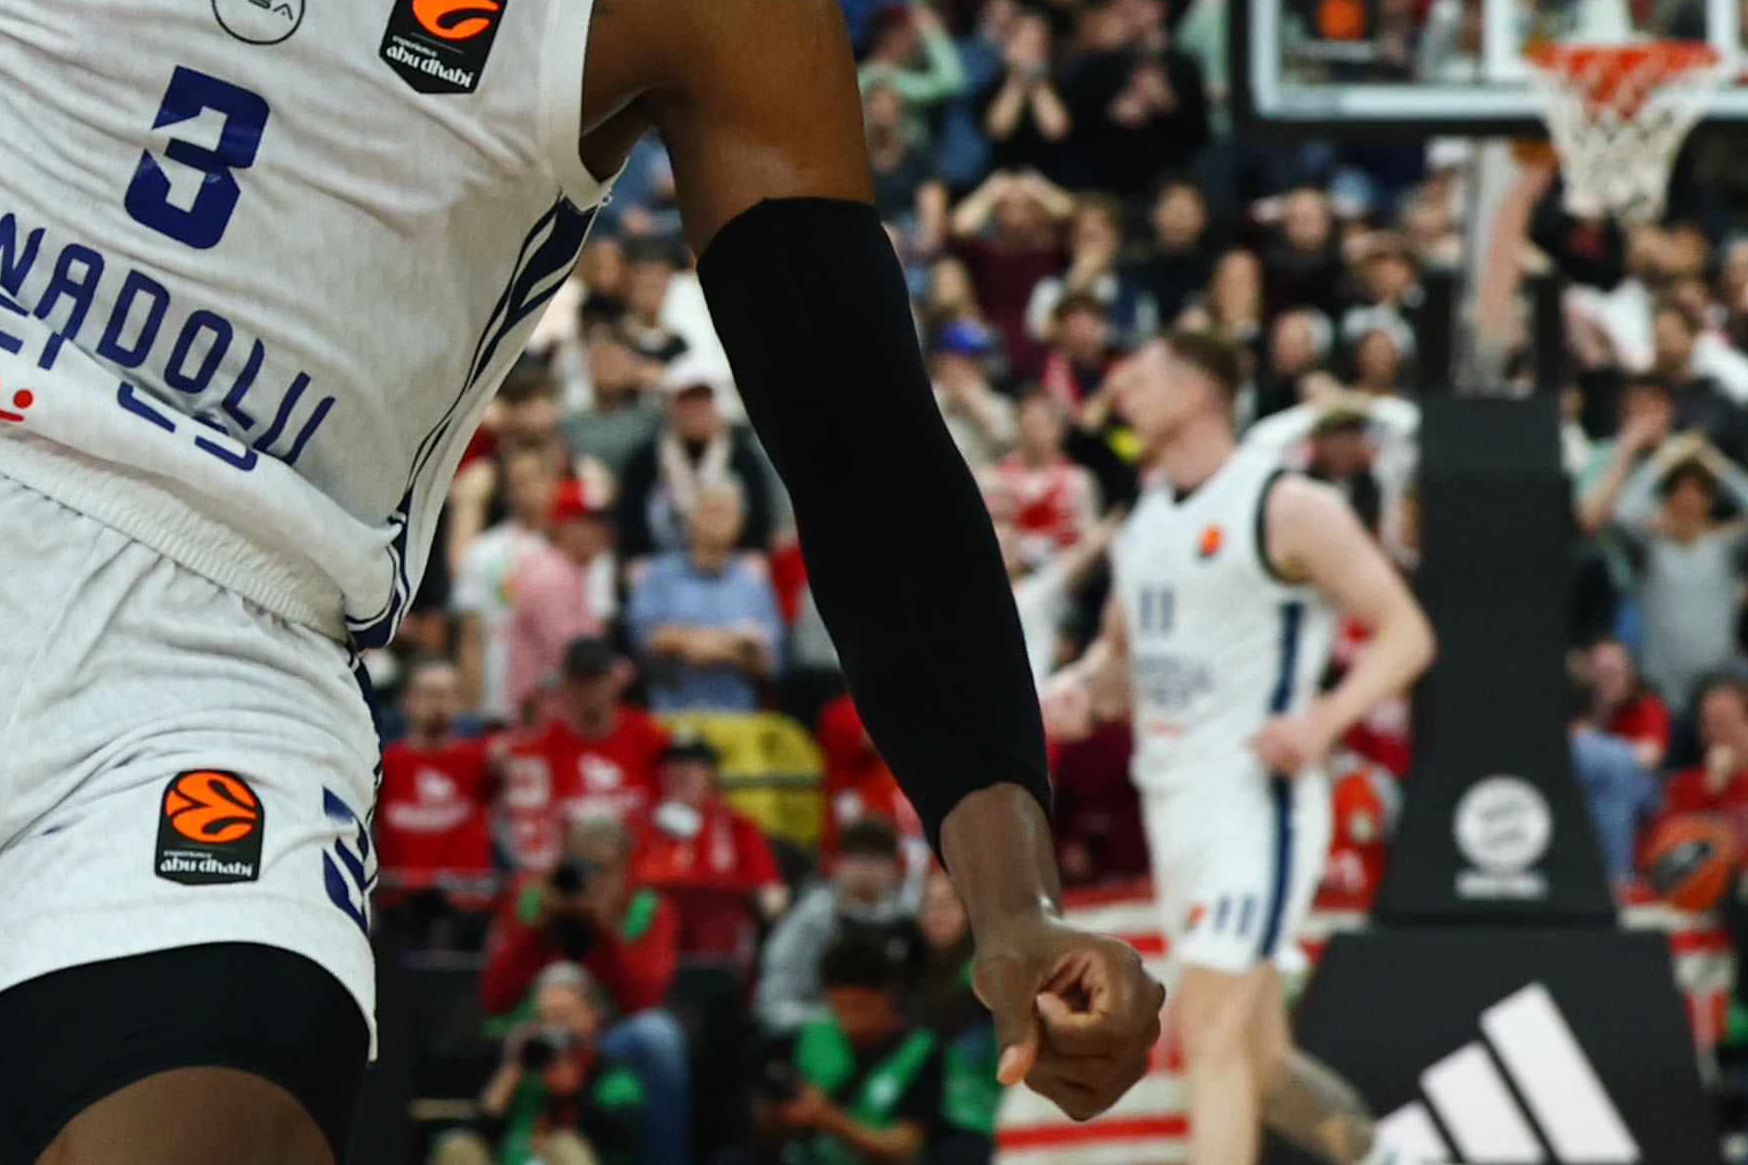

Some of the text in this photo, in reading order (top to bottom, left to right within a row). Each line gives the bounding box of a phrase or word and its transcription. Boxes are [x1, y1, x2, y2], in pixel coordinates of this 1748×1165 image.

[386, 46, 475, 89] abu dhabi
[124, 65, 270, 250] 3
[160, 858, 253, 878] abu dhabi
